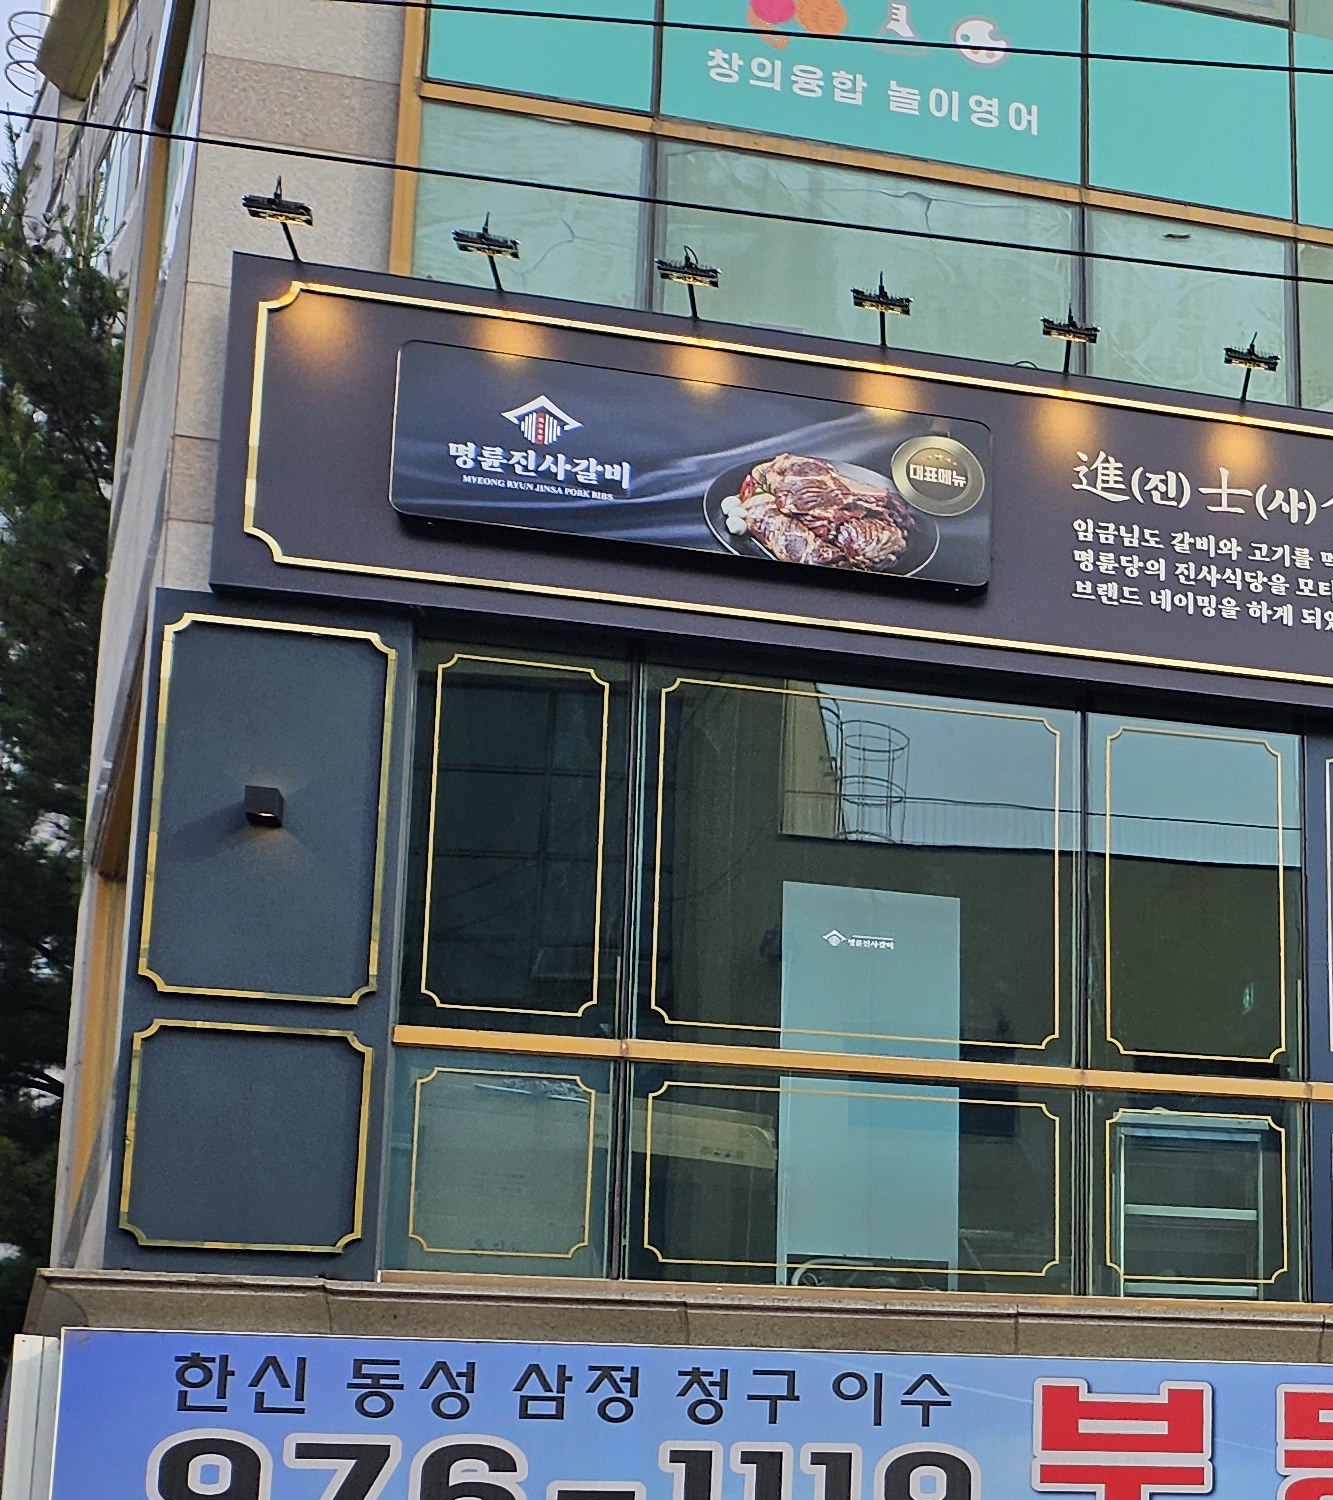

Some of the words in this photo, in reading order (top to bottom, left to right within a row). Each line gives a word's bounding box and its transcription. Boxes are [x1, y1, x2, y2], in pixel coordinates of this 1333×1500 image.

[708, 48, 868, 107] 창의융합
[887, 77, 1040, 137] 놀이영어
[447, 441, 631, 490] 명륜진사갈비
[462, 475, 505, 489] MYEONG
[507, 479, 534, 492] RYUN
[534, 482, 563, 495] JINSA
[565, 486, 590, 498] PORK
[592, 489, 615, 501] RIBS
[908, 462, 968, 489] 대표메뉴
[1072, 518, 1165, 551] 임금님도
[1170, 530, 1243, 562] 갈비와
[1248, 541, 1314, 570] 고기를
[1072, 549, 1167, 581] 명륜당의
[1173, 561, 1290, 596] 진사식당을
[1071, 580, 1144, 607] 브랜드
[1149, 589, 1241, 621] 네이밍을
[1245, 600, 1294, 627] 하게
[172, 1351, 309, 1416] 한신
[346, 1359, 479, 1421] 동성
[514, 1362, 643, 1424] 삼정
[676, 1365, 803, 1426] 청구
[831, 1370, 954, 1428] 이수
